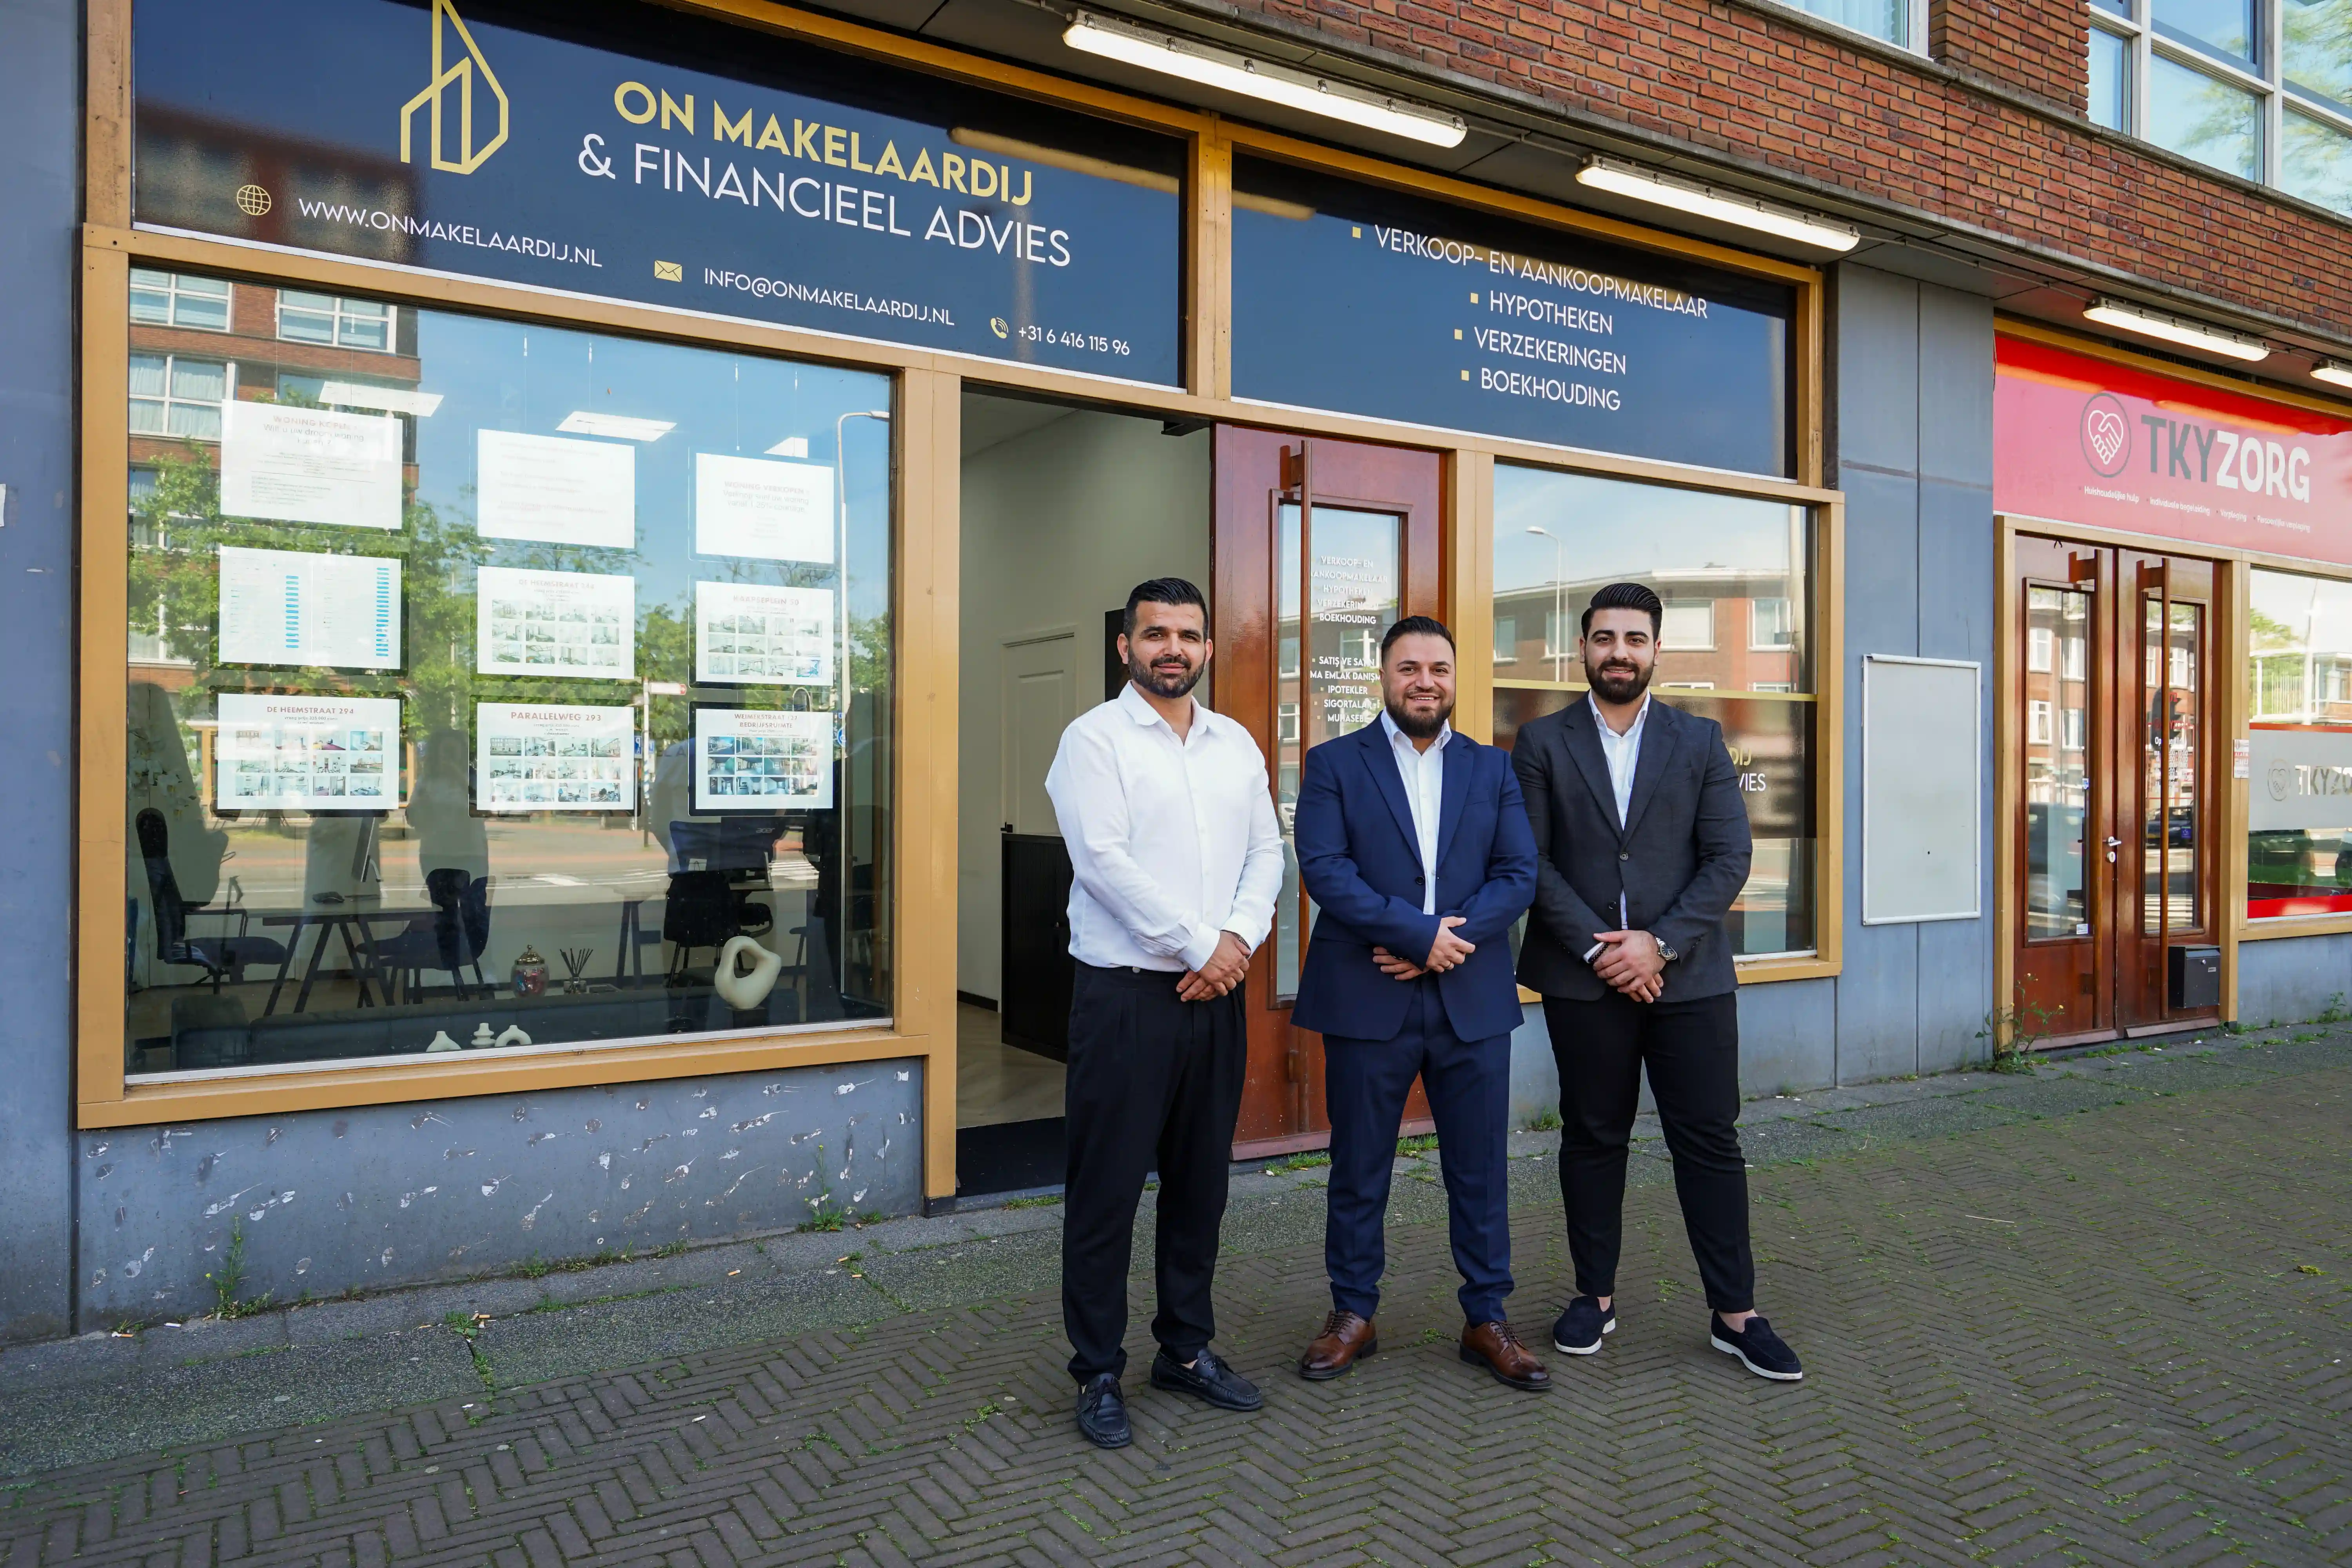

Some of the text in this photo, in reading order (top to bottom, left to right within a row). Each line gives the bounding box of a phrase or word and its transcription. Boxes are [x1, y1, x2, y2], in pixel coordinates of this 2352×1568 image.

[614, 82, 1032, 206] ON MAKELAARDIJ
[578, 134, 1071, 267] & FINANCIEEL ADVIES
[298, 198, 602, 267] WWW.ONMAKELAARDIJ.NL
[1374, 225, 1708, 318] VERKOOP- EN AANKOOPMAKELAAR
[704, 268, 955, 326] INFO@ONMAKELAARDIJ.NL
[1490, 290, 1612, 335] HYPOTHEKEN
[1018, 325, 1130, 355] +31 6 416 115 96
[1474, 327, 1626, 375] VERZEKERINGEN
[1481, 367, 1621, 410] BOEKHOUDING
[273, 416, 316, 426] WONING
[2141, 414, 2310, 504] TKYZORG
[2084, 486, 2140, 504] Huishoudelijke hulp
[2150, 497, 2210, 516] Individuele begeleiding
[2220, 508, 2247, 522] Verpleging
[2257, 515, 2310, 533] Persoonlijke verpleging
[1321, 555, 1374, 568] VERKOOP- EN
[1310, 570, 1388, 583] ANKOOPMAKELAAR
[1319, 613, 1377, 624] BOEKHOUDING
[1319, 656, 1340, 668] SATIŞ
[1341, 657, 1352, 666] VE
[1325, 671, 1351, 680] EMLAK
[1328, 685, 1368, 695] IPOTEKLER
[1324, 699, 1372, 710] SIGORTALAR
[511, 712, 581, 721] PARALLELWEG
